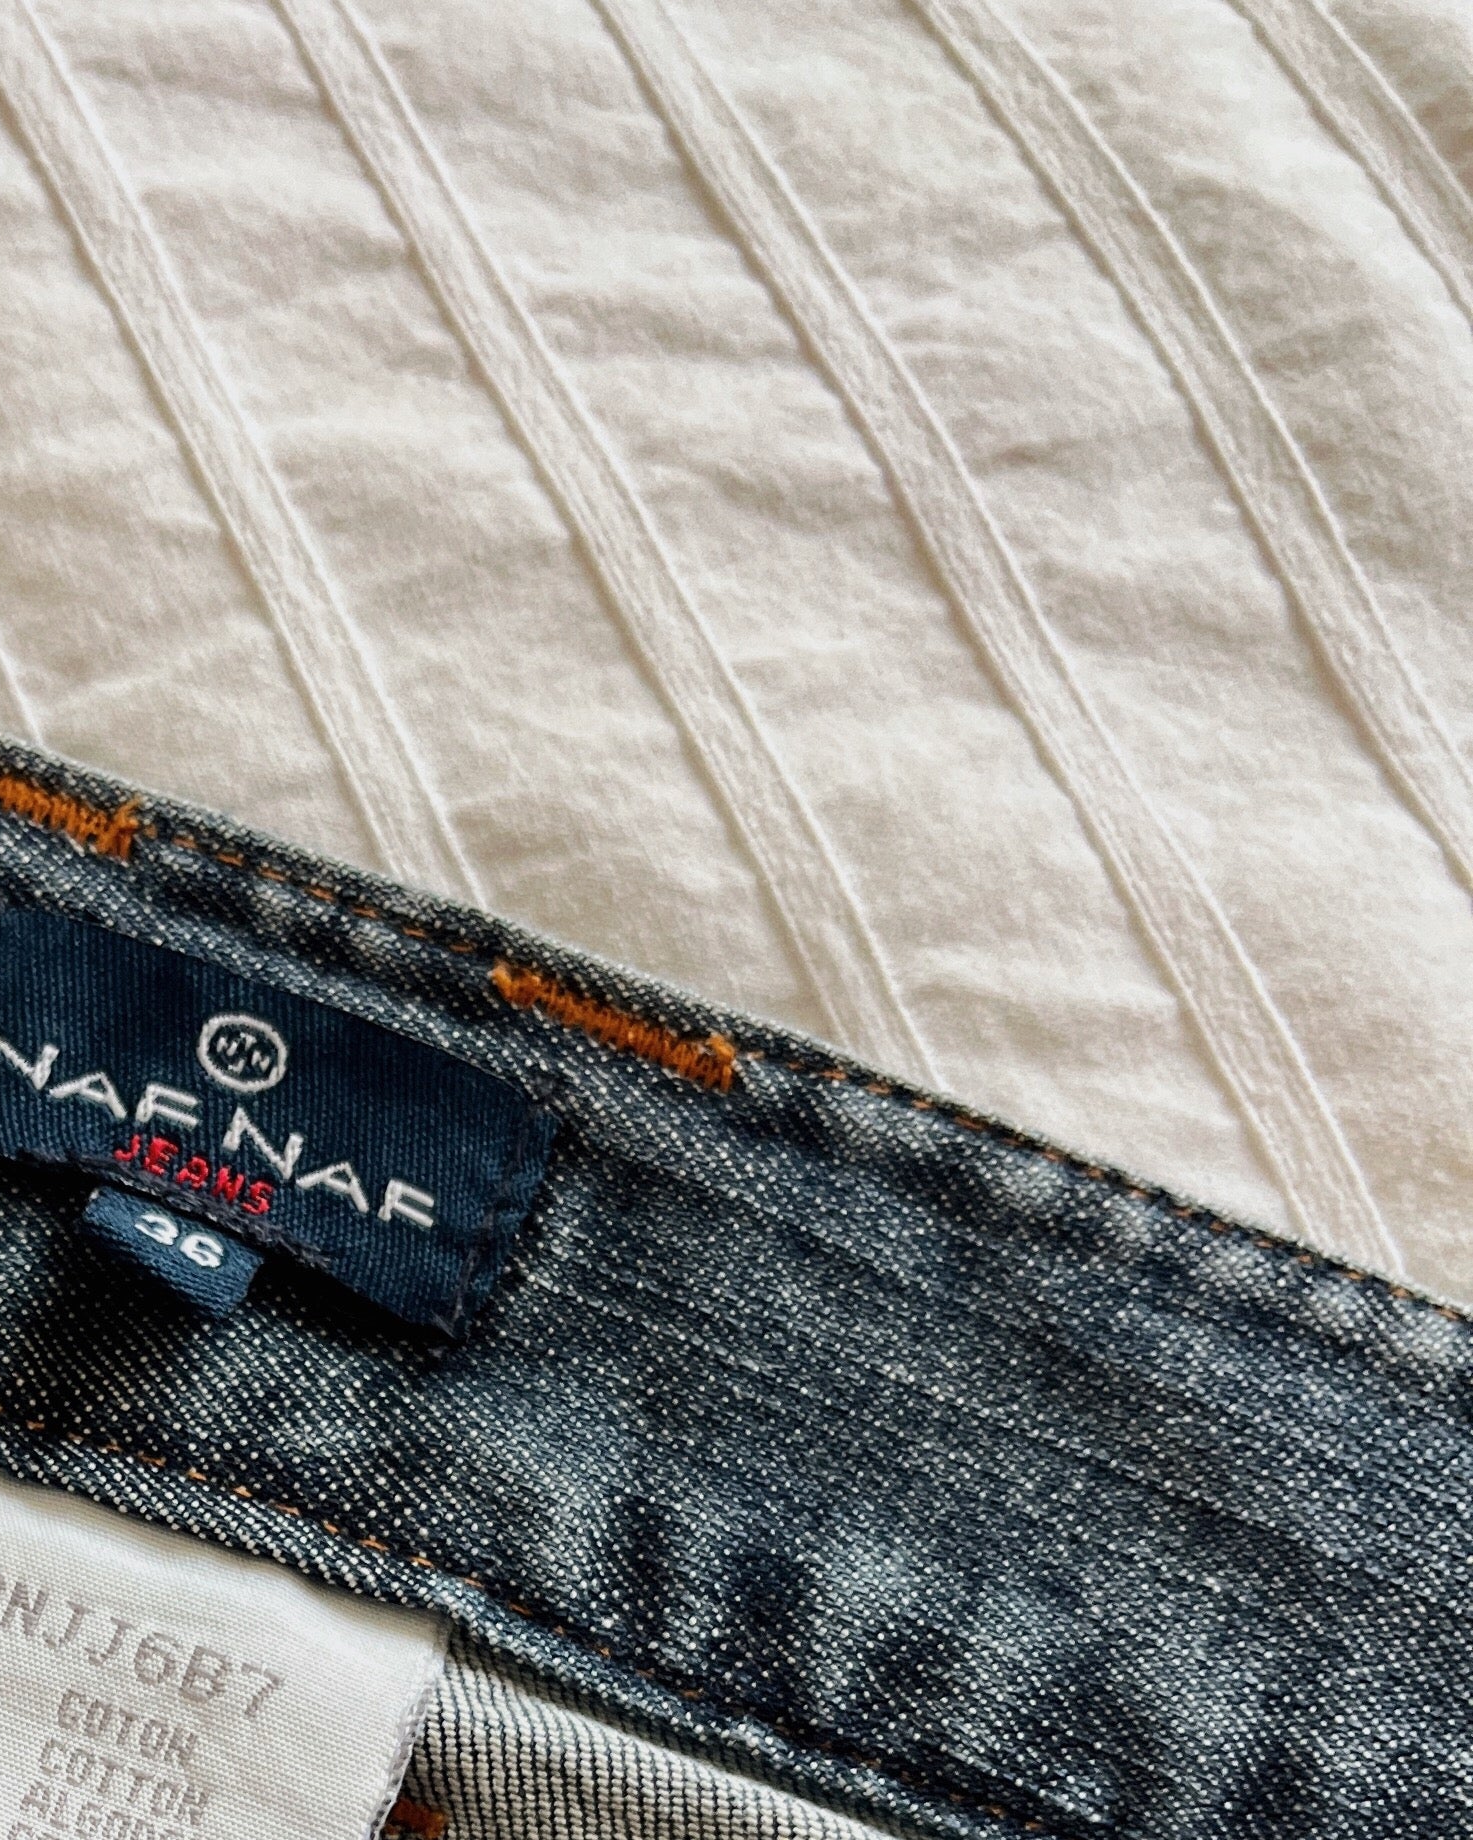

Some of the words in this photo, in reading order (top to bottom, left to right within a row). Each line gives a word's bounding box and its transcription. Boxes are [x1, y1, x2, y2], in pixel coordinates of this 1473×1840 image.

[112, 1133, 279, 1215] JEANS
[222, 1106, 434, 1229] NAF
[134, 1212, 224, 1269] 36
[36, 1736, 210, 1826] COTTON
